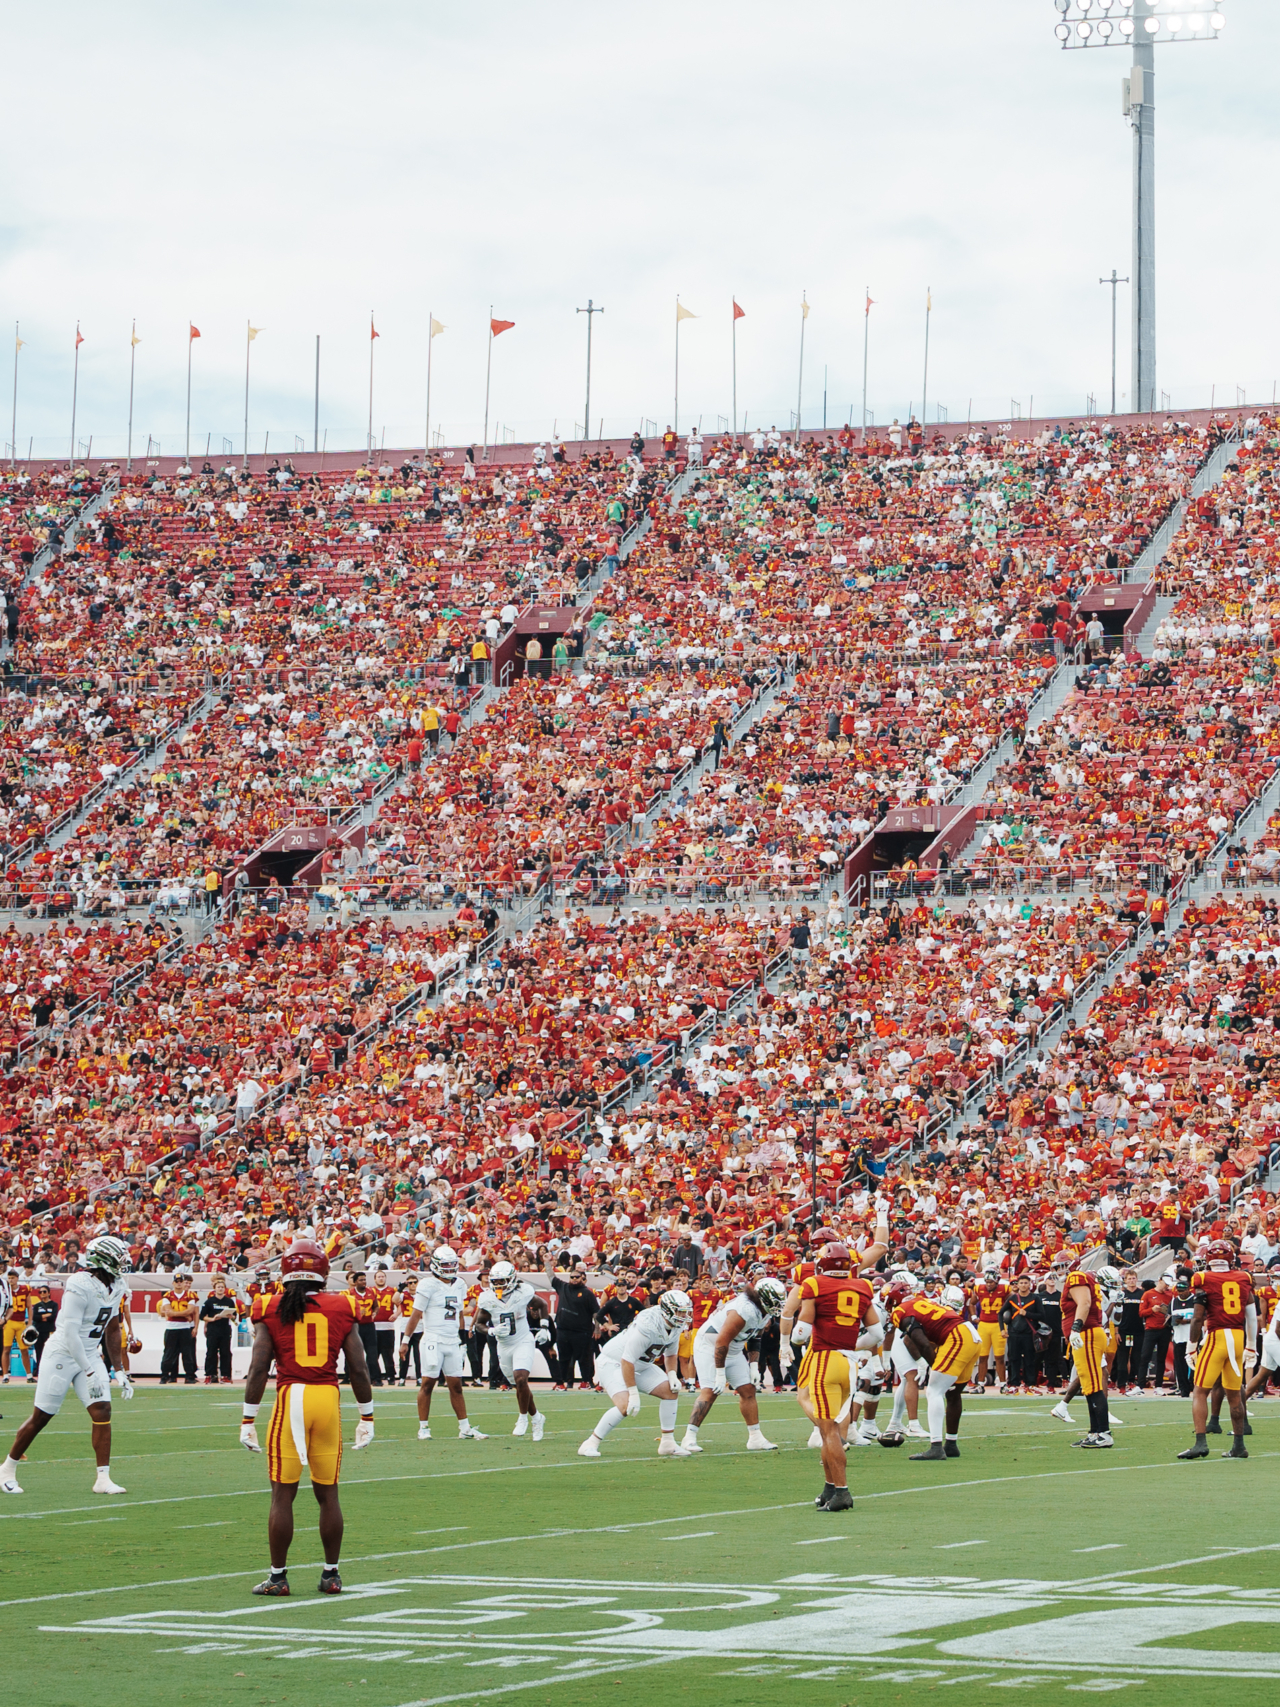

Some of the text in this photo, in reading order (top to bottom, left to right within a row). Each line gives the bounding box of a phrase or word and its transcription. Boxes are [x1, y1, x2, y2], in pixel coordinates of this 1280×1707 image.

[895, 816, 904, 827] 21
[290, 835, 303, 845] 20
[1153, 900, 1162, 911] 14
[1028, 1176, 1034, 1186] 2
[1163, 1205, 1178, 1219] 55
[1069, 1275, 1080, 1285] 91
[980, 1298, 1003, 1314] 44
[1222, 1281, 1242, 1314] 8
[444, 1296, 458, 1320] 5
[701, 1299, 713, 1318] 7
[835, 1290, 860, 1326] 9
[88, 1307, 113, 1338] 9
[499, 1312, 516, 1335] 0
[294, 1312, 329, 1367] 0
[153, 1642, 1150, 1691] RIVALRY SERIES
